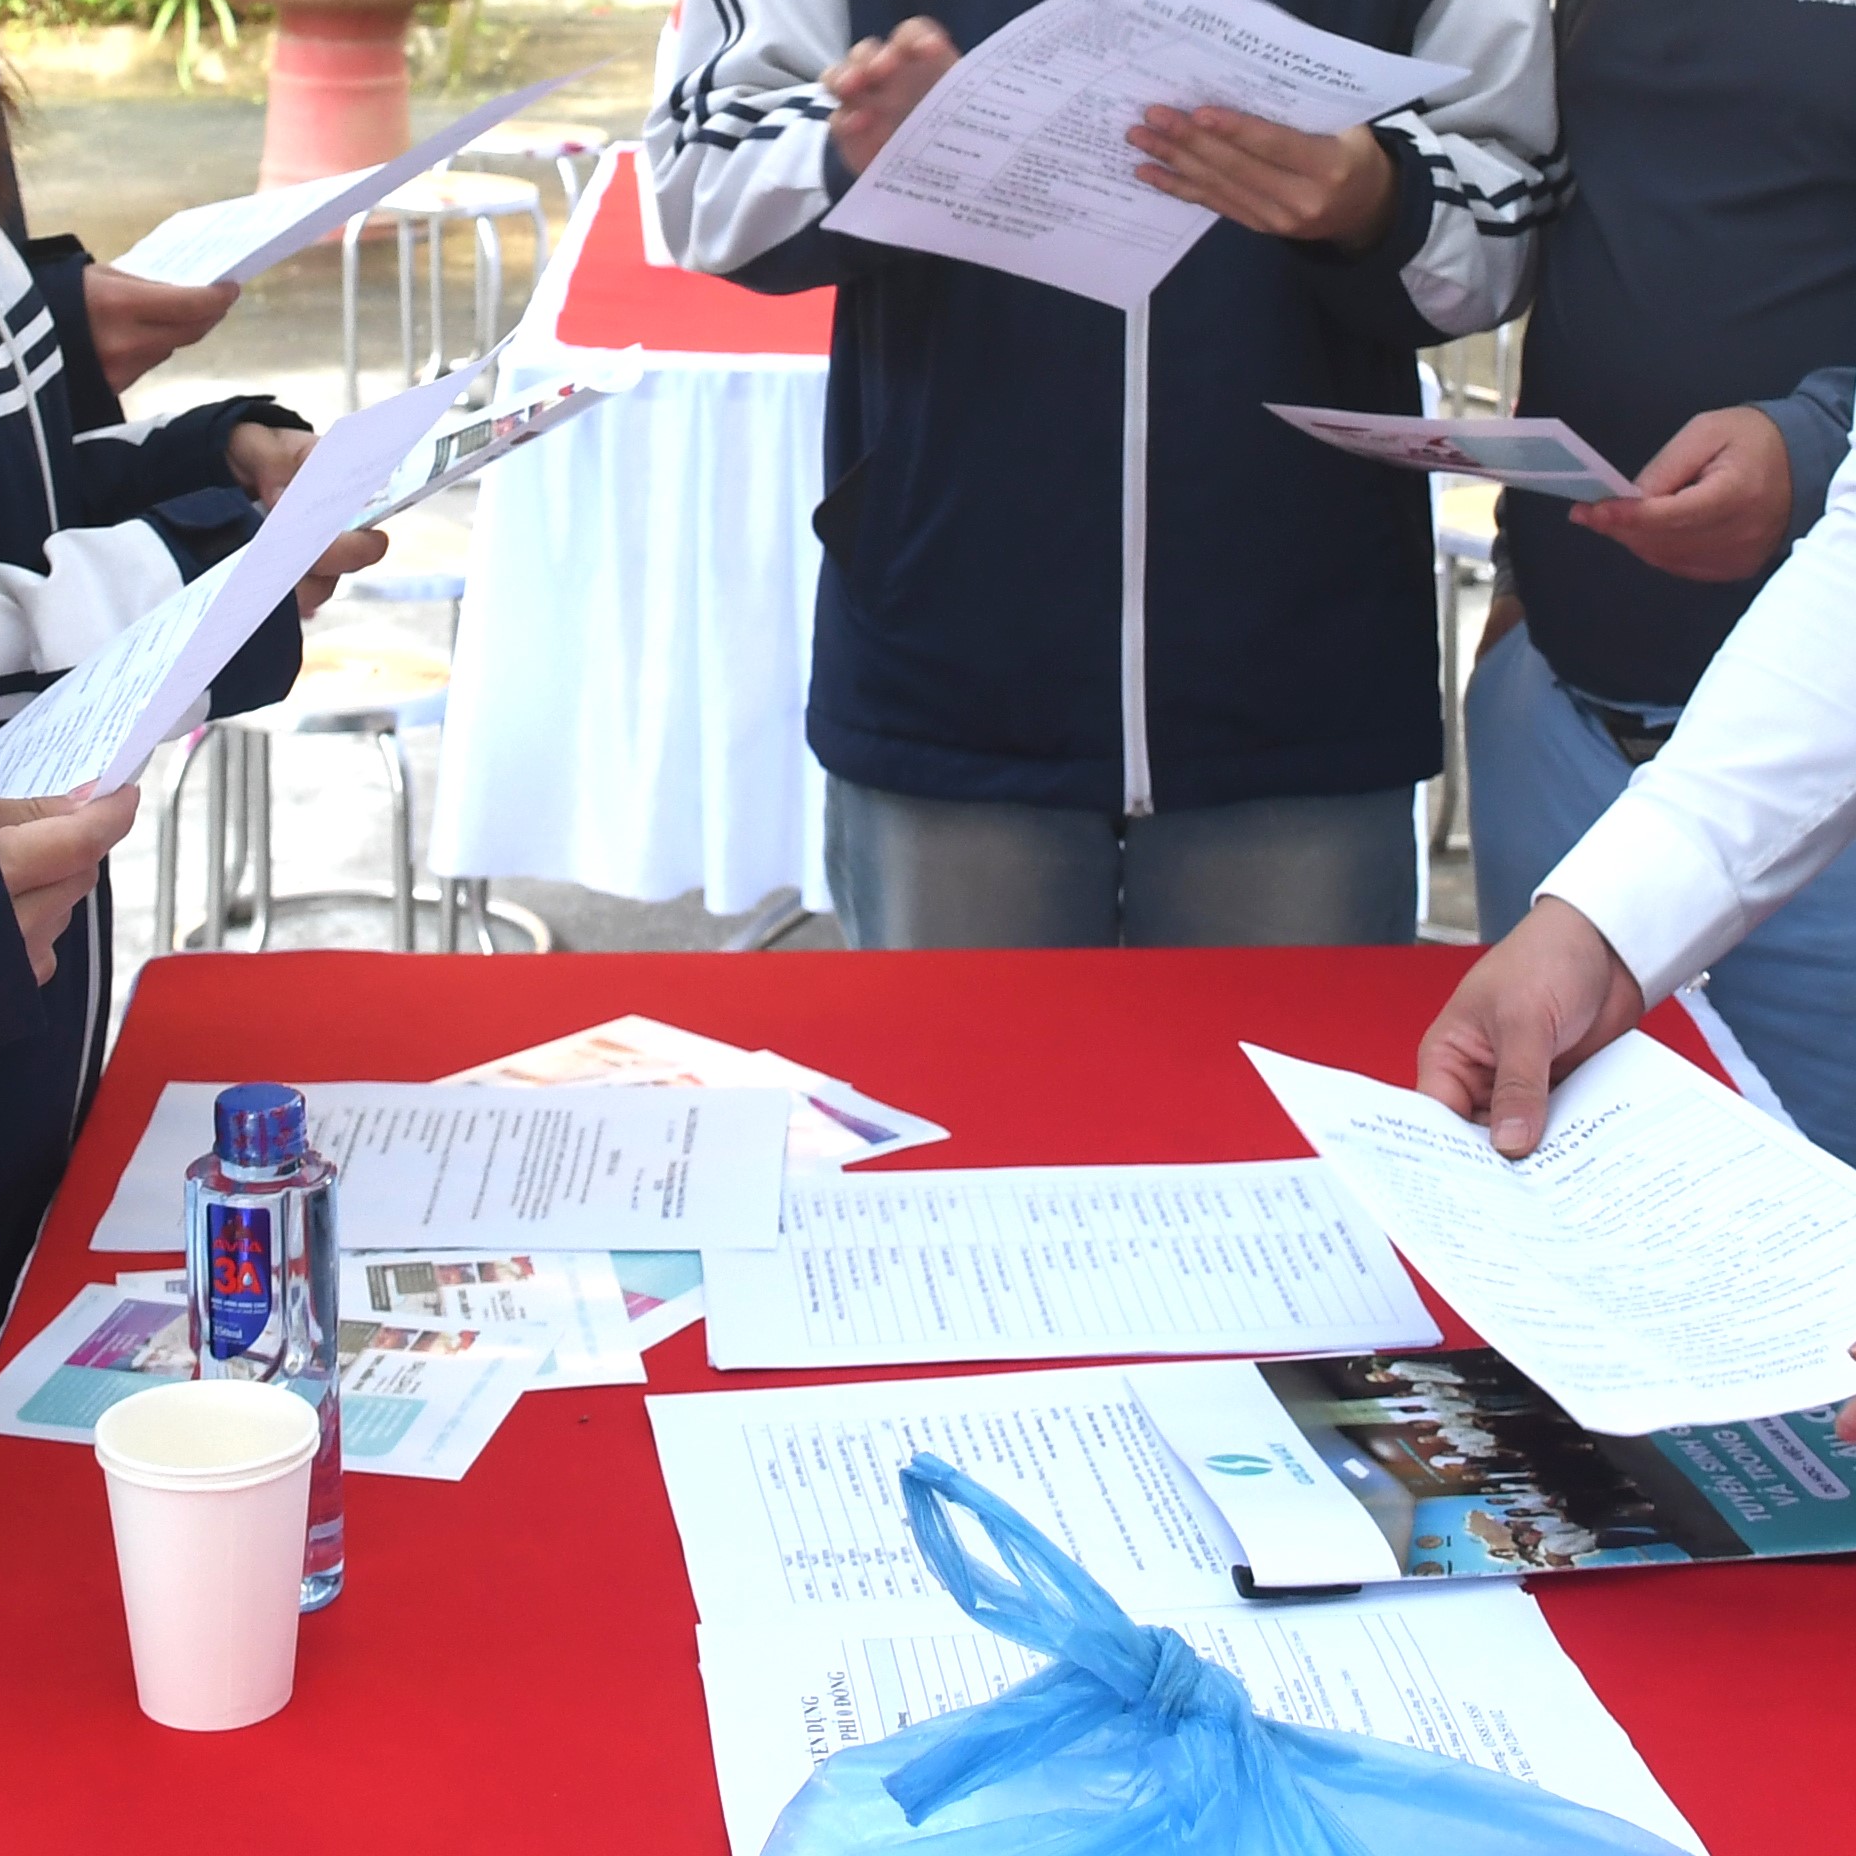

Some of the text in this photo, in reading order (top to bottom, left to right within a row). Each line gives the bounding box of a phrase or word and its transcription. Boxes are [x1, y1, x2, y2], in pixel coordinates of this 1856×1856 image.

[213, 1256, 263, 1296] 3A
[1675, 1439, 1728, 1472] SINH
[1711, 1429, 1800, 1506] VÀ TRONG
